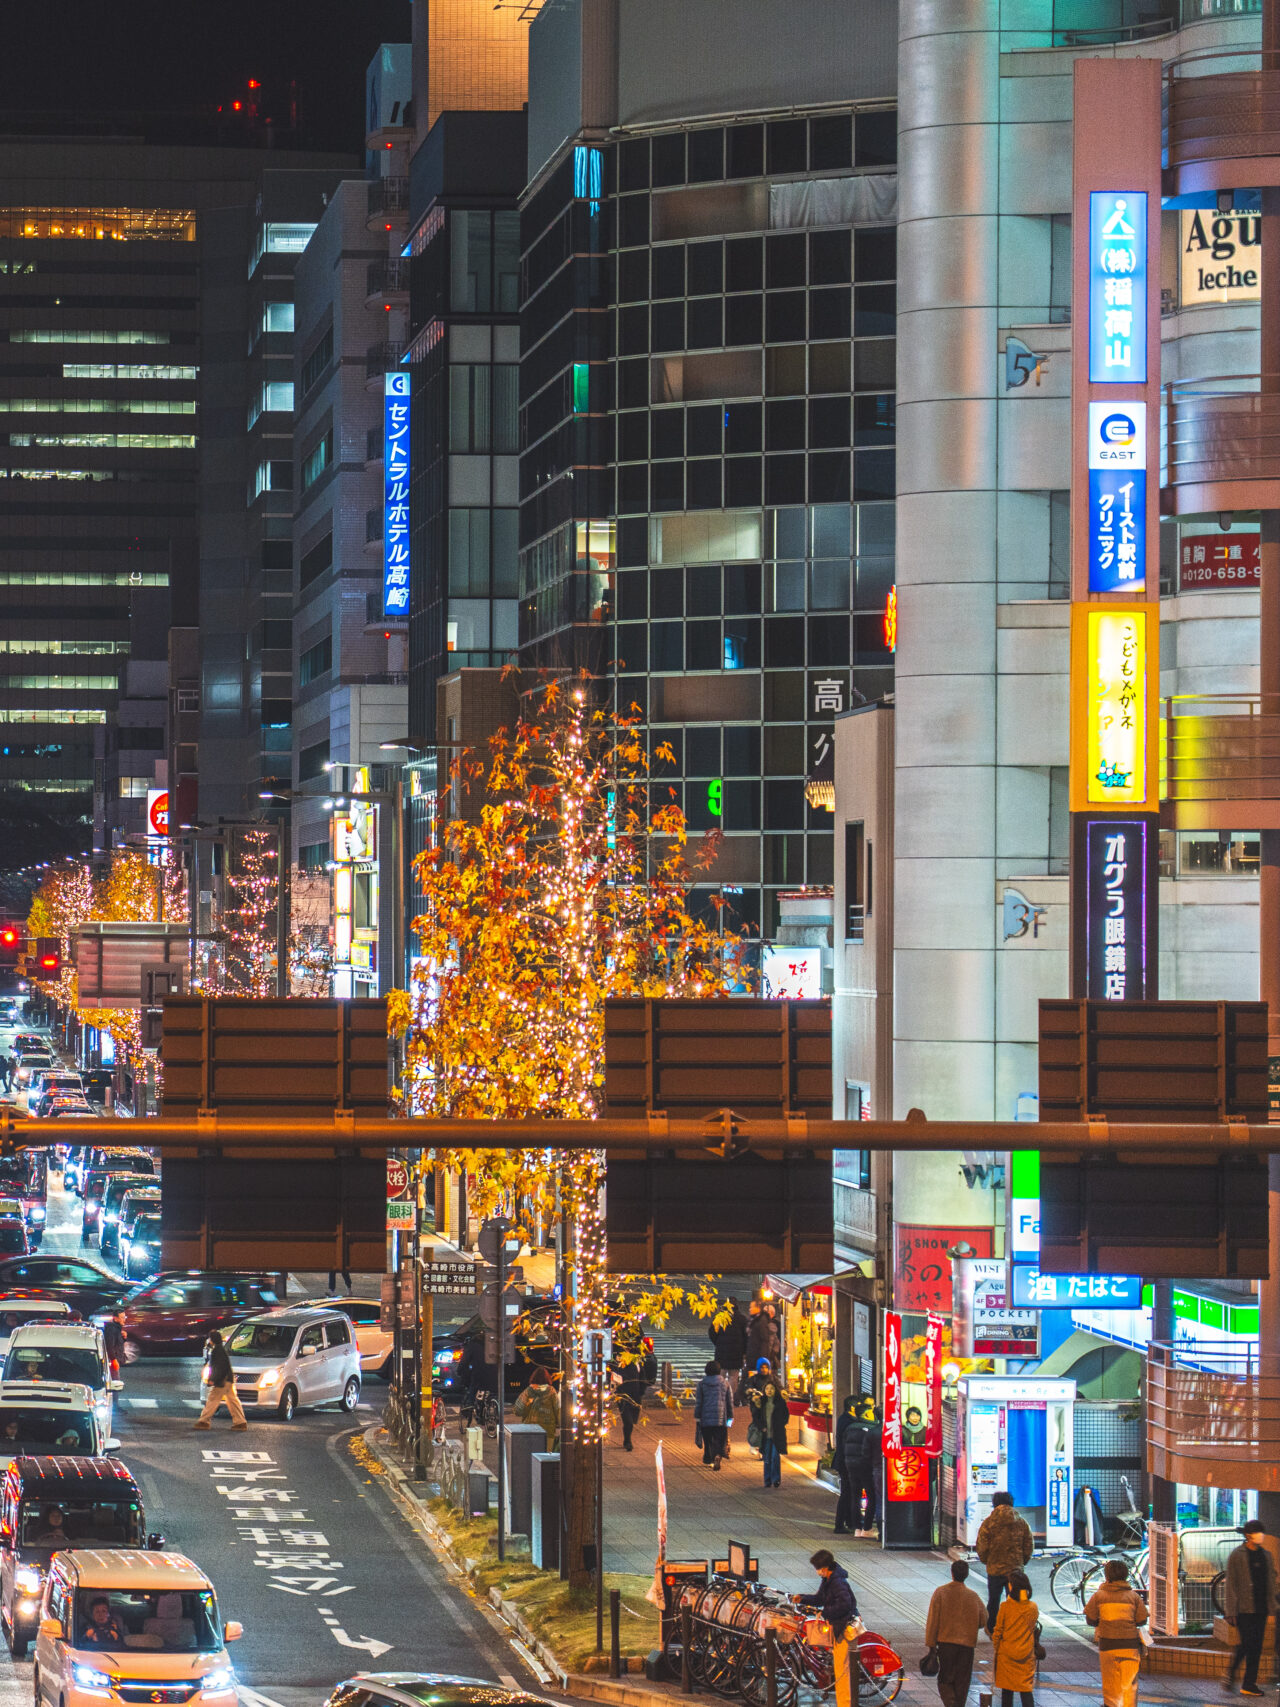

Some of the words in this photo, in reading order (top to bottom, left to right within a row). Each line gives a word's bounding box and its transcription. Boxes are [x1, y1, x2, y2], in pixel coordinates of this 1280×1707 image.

[1198, 265, 1257, 291] leche
[1012, 353, 1050, 387] 5F
[1099, 451, 1136, 460] EAST
[1098, 494, 1115, 570] クリニック
[1117, 481, 1136, 580] イースト駅前
[1213, 545, 1243, 560] 二重
[1008, 903, 1048, 939] 3F
[1104, 835, 1127, 1000] オグラ眼鏡店
[430, 1263, 475, 1272] 高崎市役所
[974, 1264, 1001, 1274] WEST
[430, 1286, 476, 1294] 高崎市美術館
[1027, 1271, 1057, 1301] 酒
[1067, 1276, 1129, 1298] たばこ
[980, 1310, 1032, 1318] POCKET
[1016, 1326, 1031, 1339] 2F
